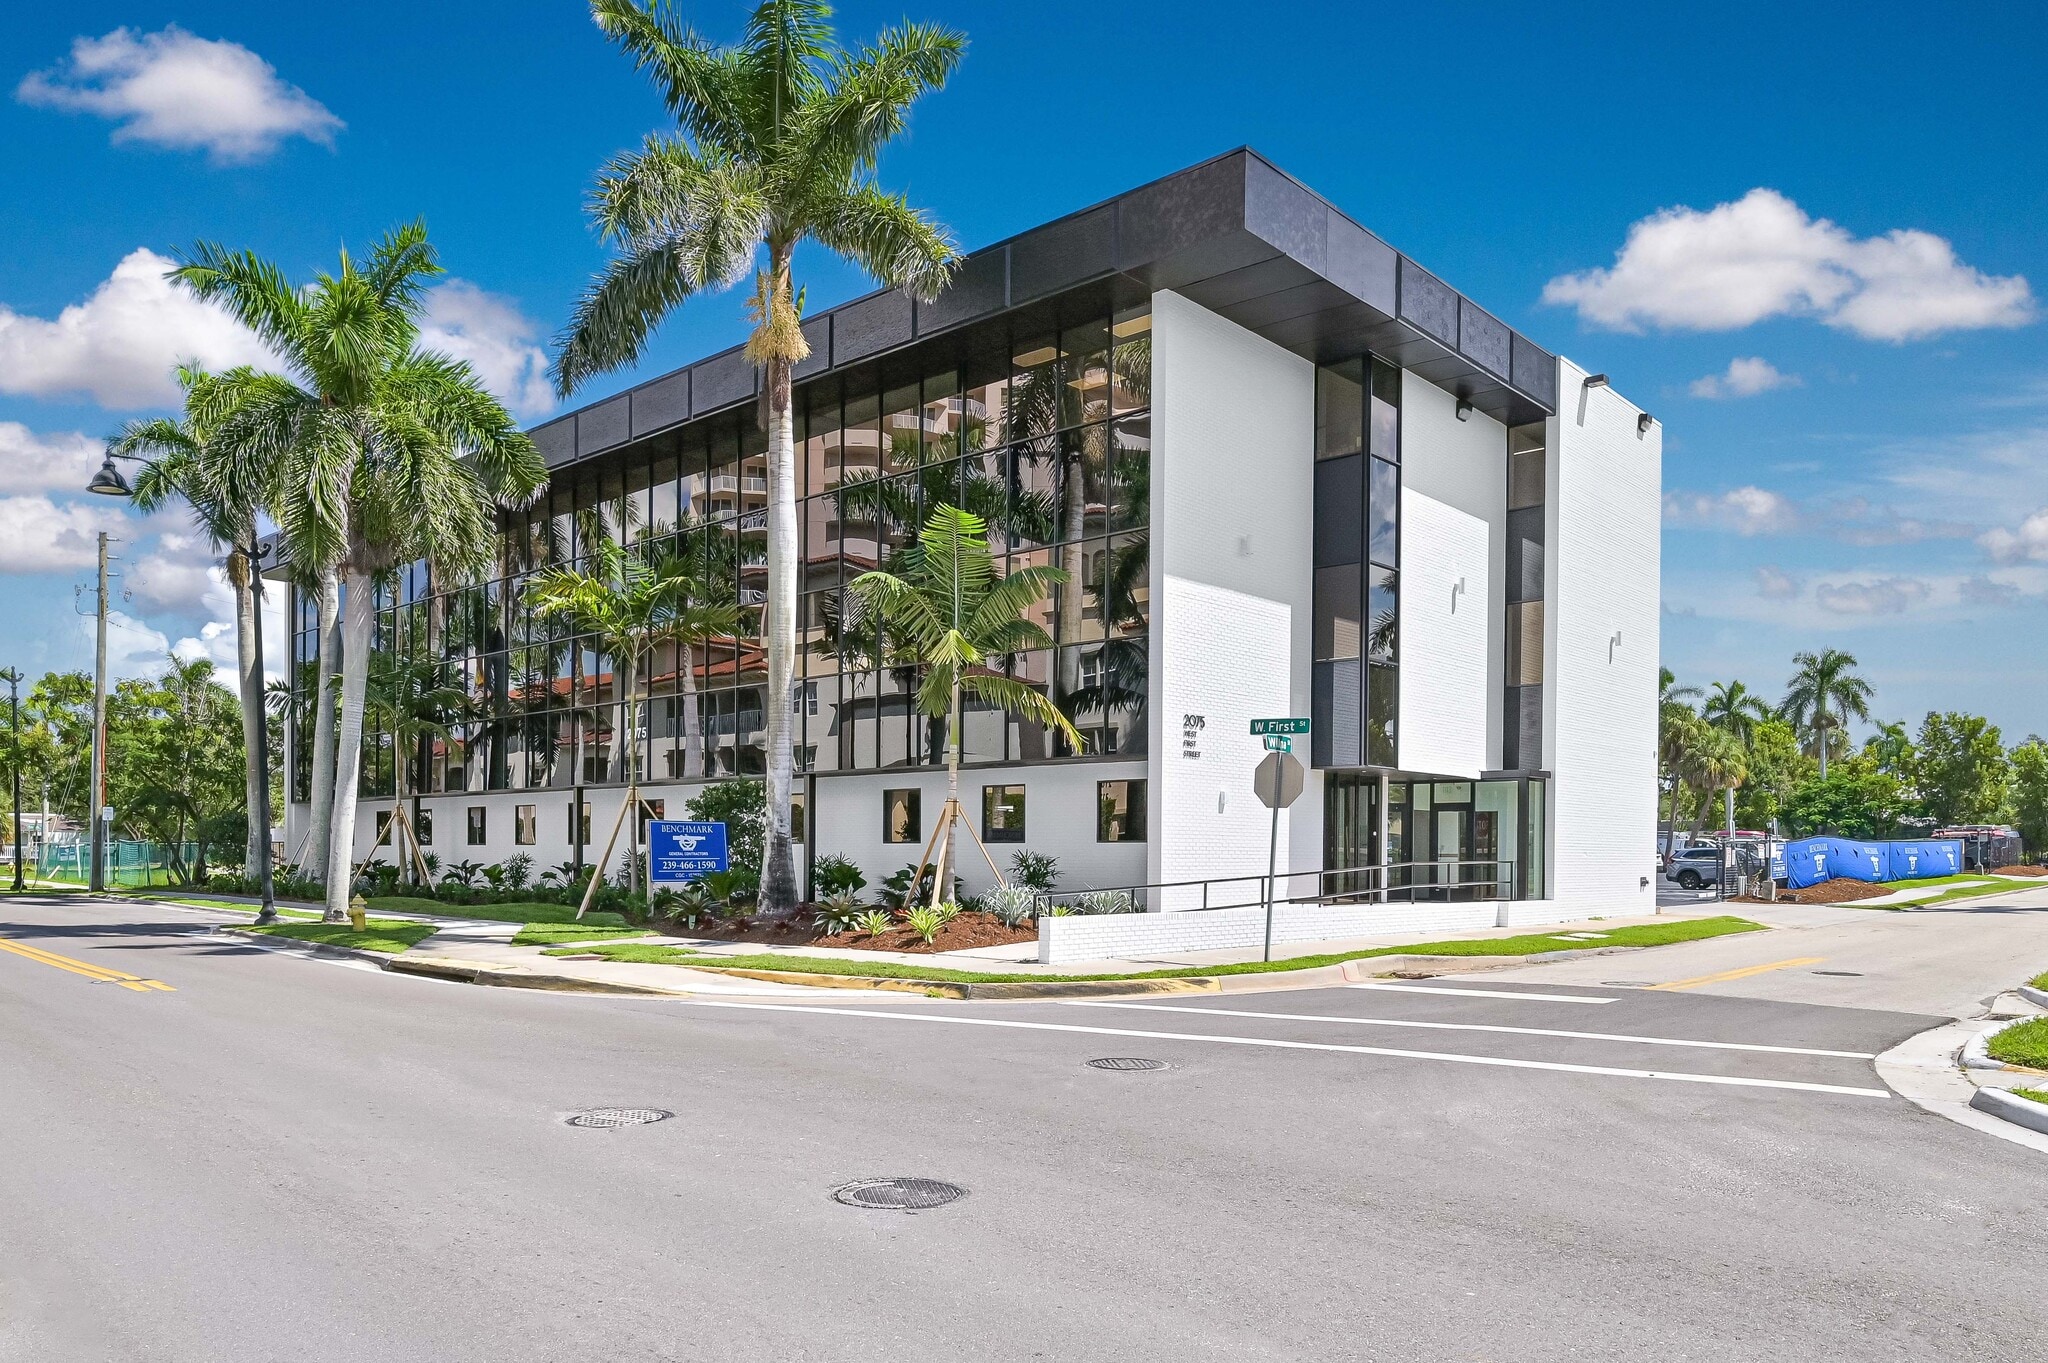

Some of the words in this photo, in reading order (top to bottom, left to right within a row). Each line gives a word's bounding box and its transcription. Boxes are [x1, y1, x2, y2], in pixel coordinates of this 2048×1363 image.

[1183, 714, 1205, 729] 2075
[1254, 722, 1266, 732] W.
[1268, 721, 1295, 732] First
[1183, 730, 1197, 739] WEST
[1183, 740, 1197, 749] FIRST
[1183, 751, 1201, 759] STREET
[661, 824, 714, 833] BENCHMARK
[662, 860, 716, 870] 239-466-1590
